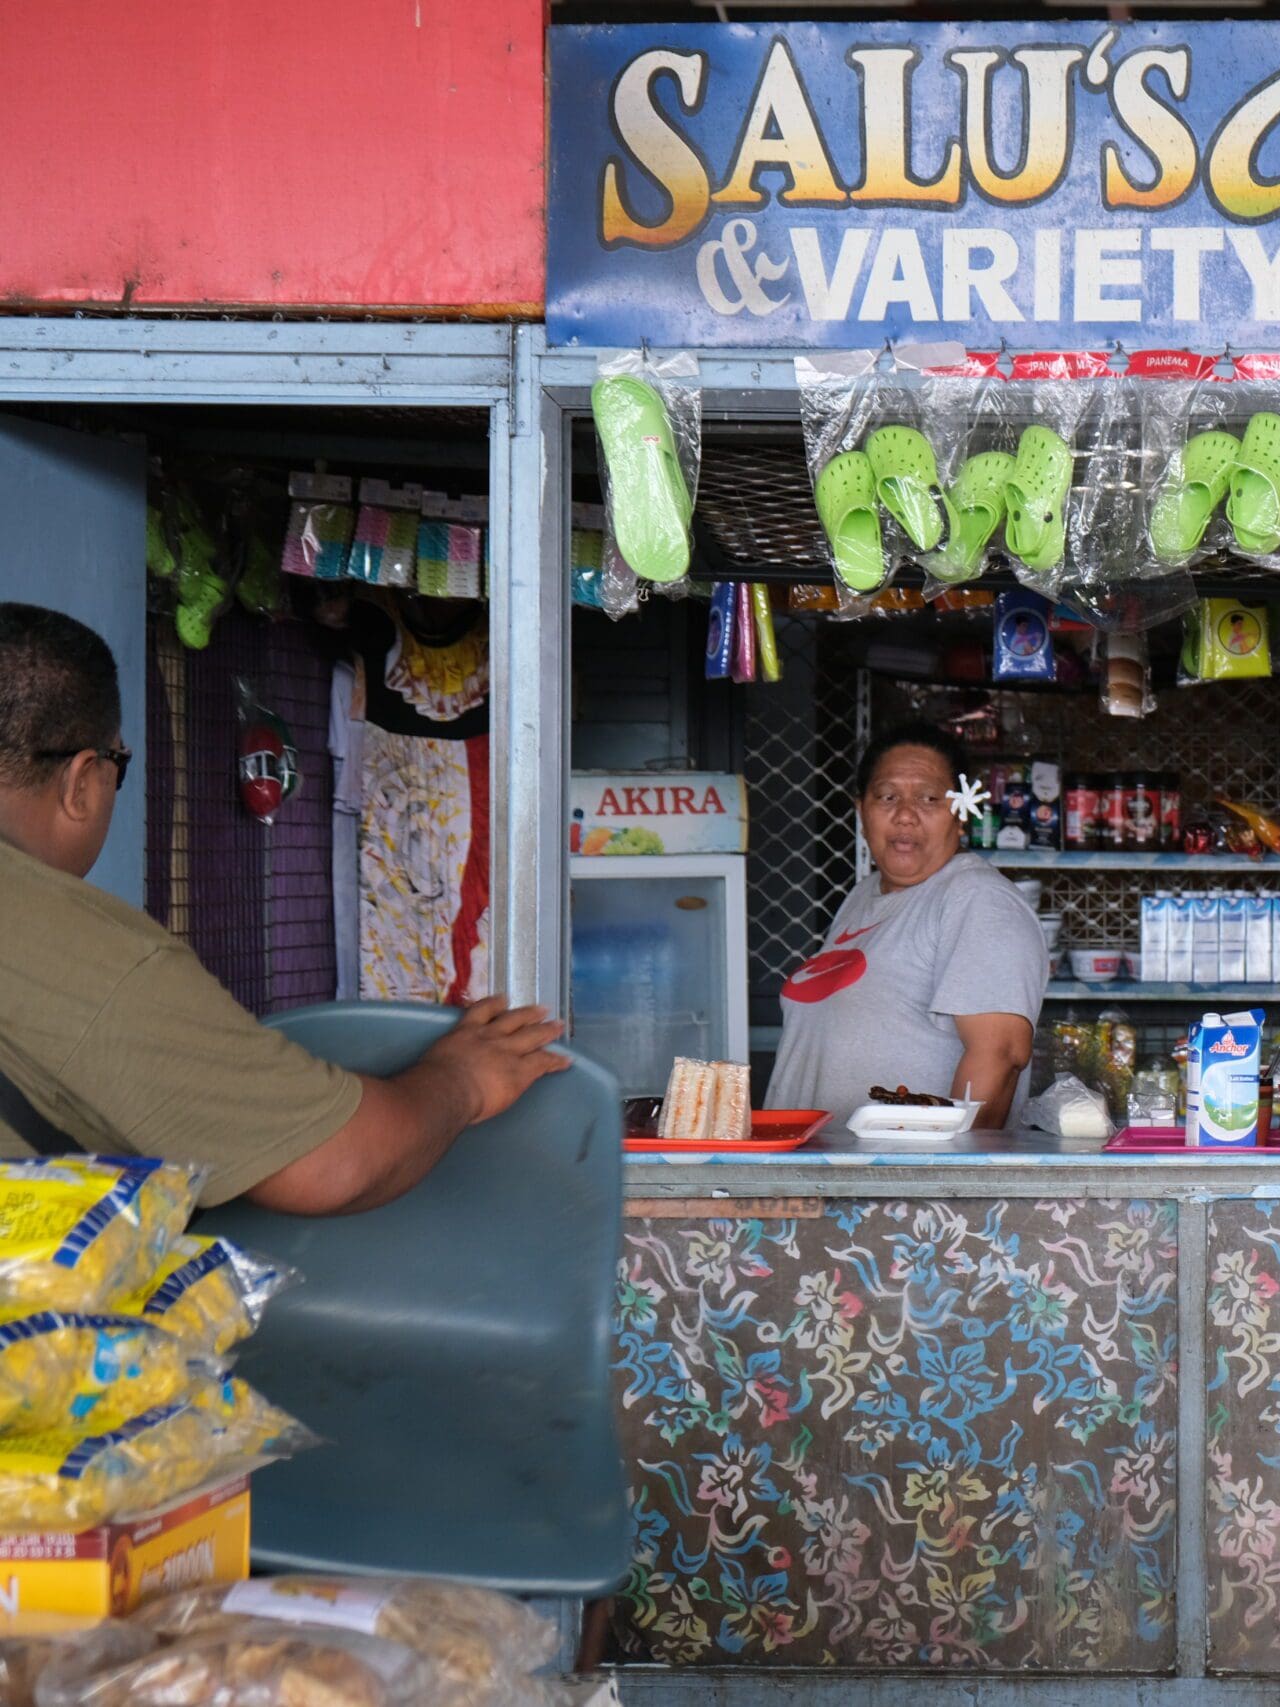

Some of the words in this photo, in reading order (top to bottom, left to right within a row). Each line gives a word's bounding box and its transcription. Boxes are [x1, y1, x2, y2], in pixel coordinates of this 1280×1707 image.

[600, 30, 1199, 250] SALU'S
[696, 218, 792, 317] &
[596, 785, 727, 816] AKIRA
[1209, 1041, 1249, 1053] Anchor
